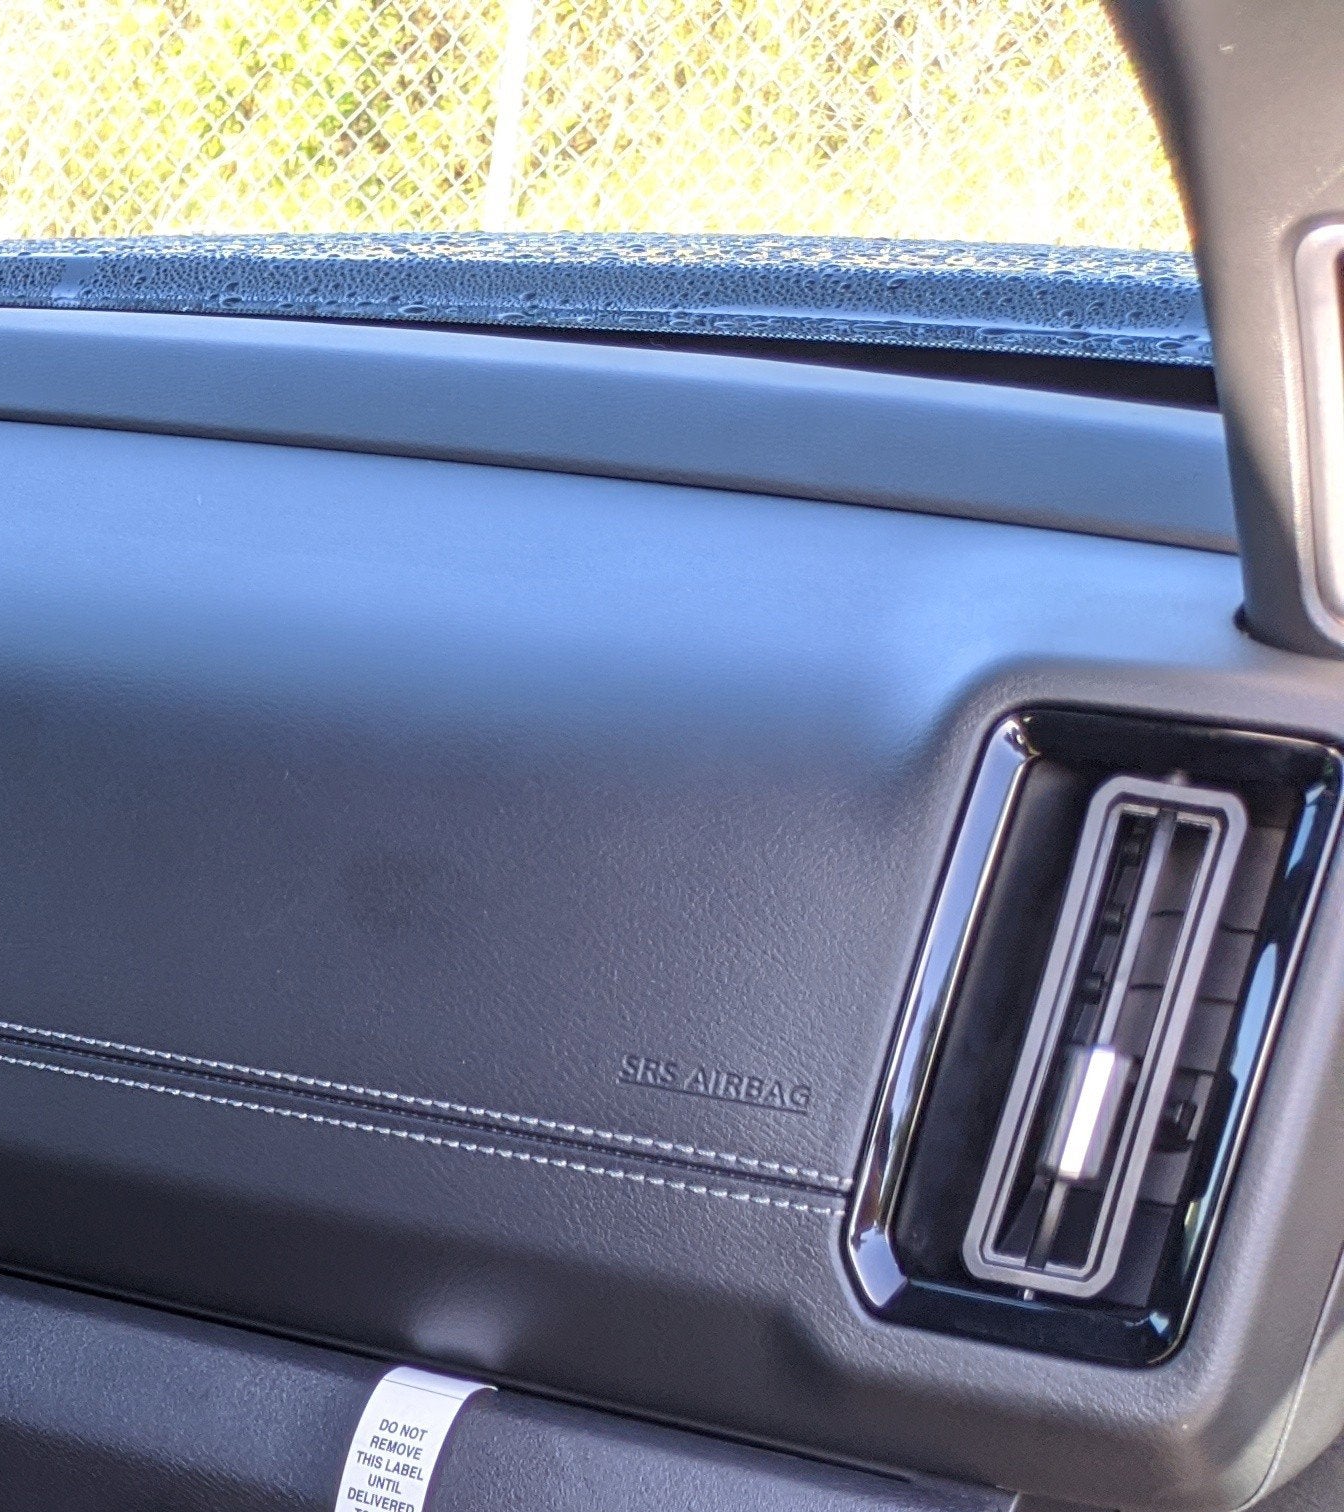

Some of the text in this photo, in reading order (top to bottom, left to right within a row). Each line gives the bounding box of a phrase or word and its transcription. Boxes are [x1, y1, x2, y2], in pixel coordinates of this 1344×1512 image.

[619, 1054, 812, 1108] SRS AIRBAG
[379, 1418, 428, 1442] DO NOT
[369, 1435, 423, 1460] REMOVE
[356, 1450, 424, 1481] THIS LABEL
[367, 1473, 402, 1494] UNTIL
